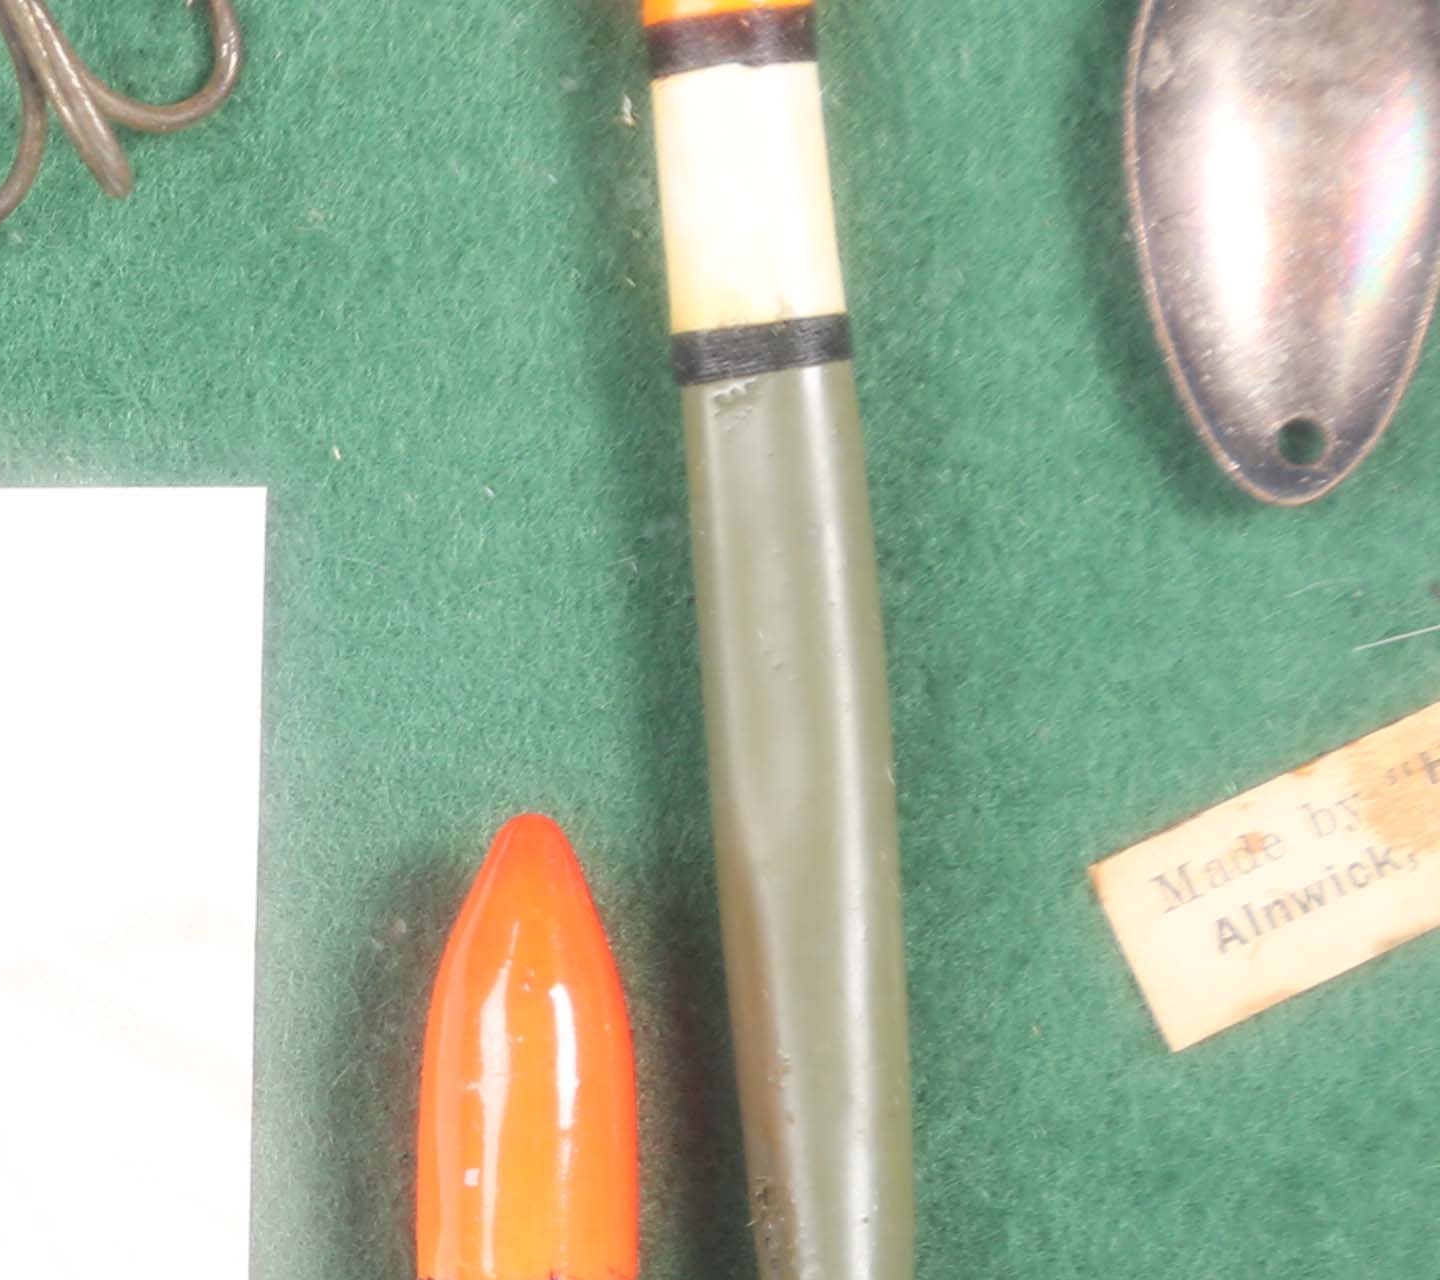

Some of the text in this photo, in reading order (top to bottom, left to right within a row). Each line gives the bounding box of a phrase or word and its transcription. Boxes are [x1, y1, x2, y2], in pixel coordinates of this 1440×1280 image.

[1147, 792, 1362, 914] Made by
[1214, 845, 1419, 956] Alnwick,
